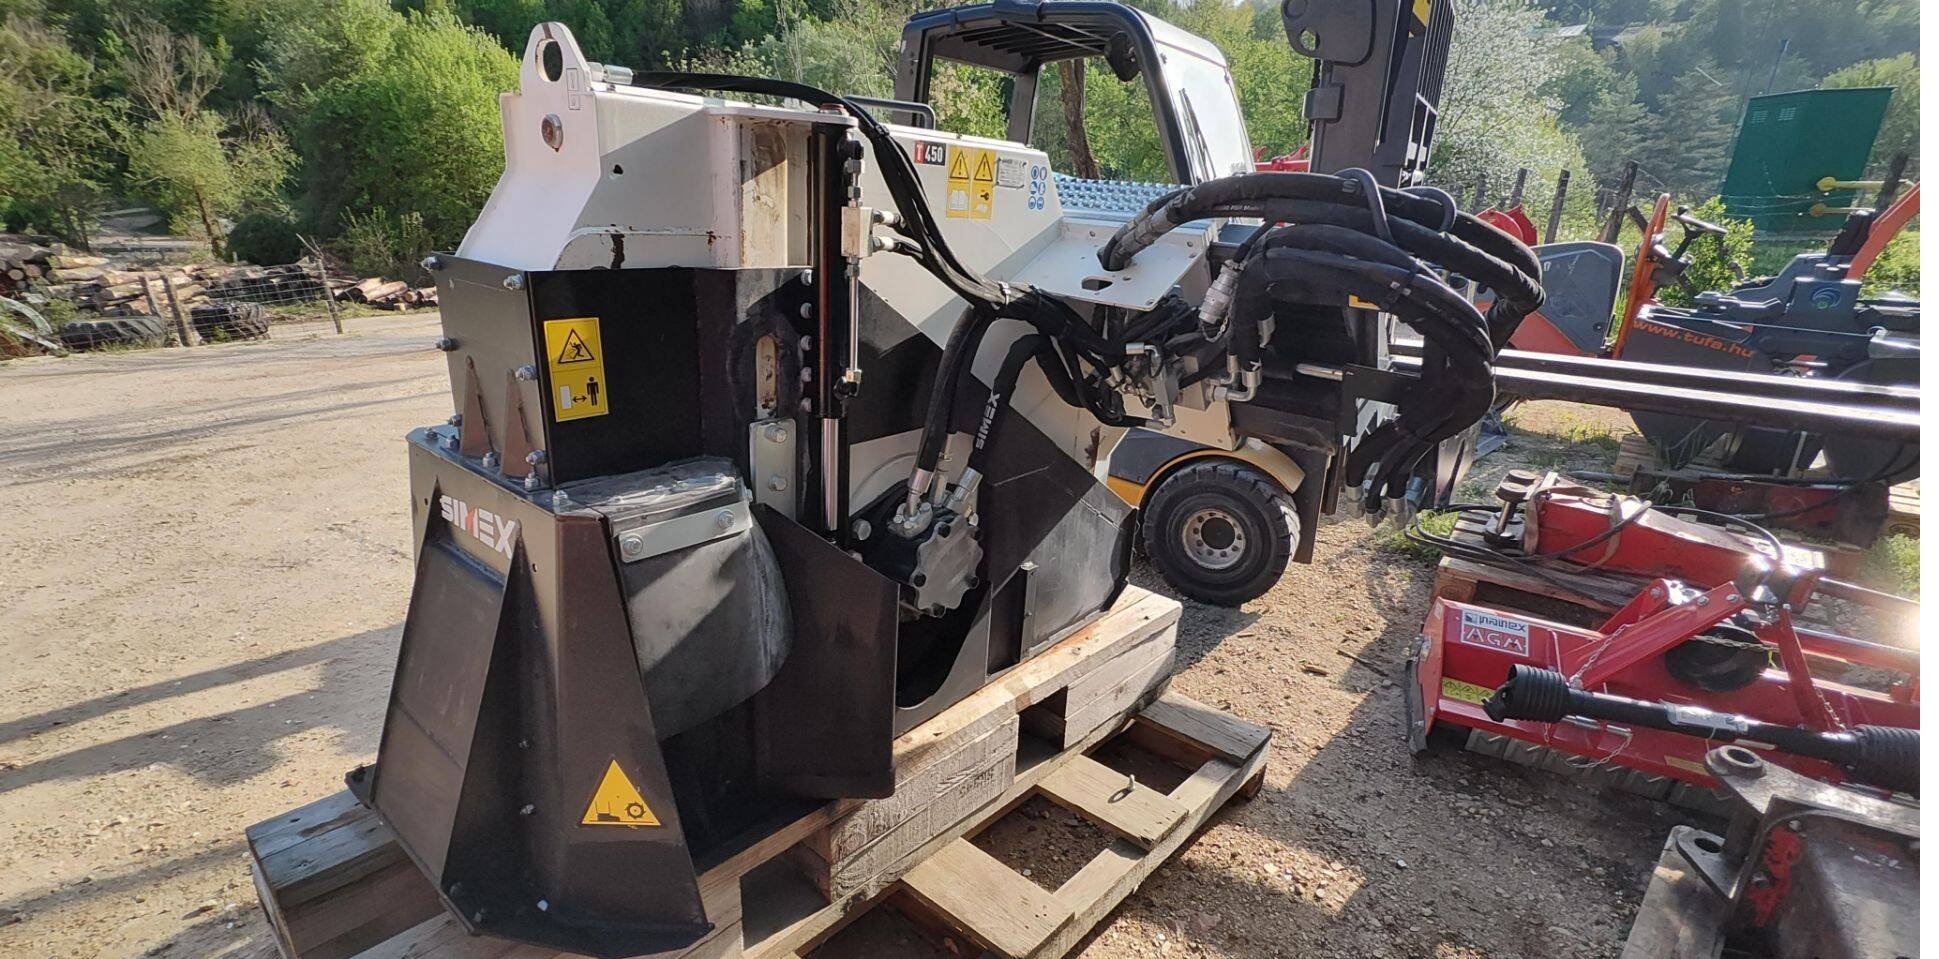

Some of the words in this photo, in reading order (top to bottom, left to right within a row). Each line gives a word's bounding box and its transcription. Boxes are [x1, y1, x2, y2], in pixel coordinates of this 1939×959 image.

[1633, 319, 1756, 359] www.tufa.hu
[976, 390, 1000, 450] SIMEX
[439, 495, 516, 560] SIMEX
[1466, 627, 1523, 651] AGM
